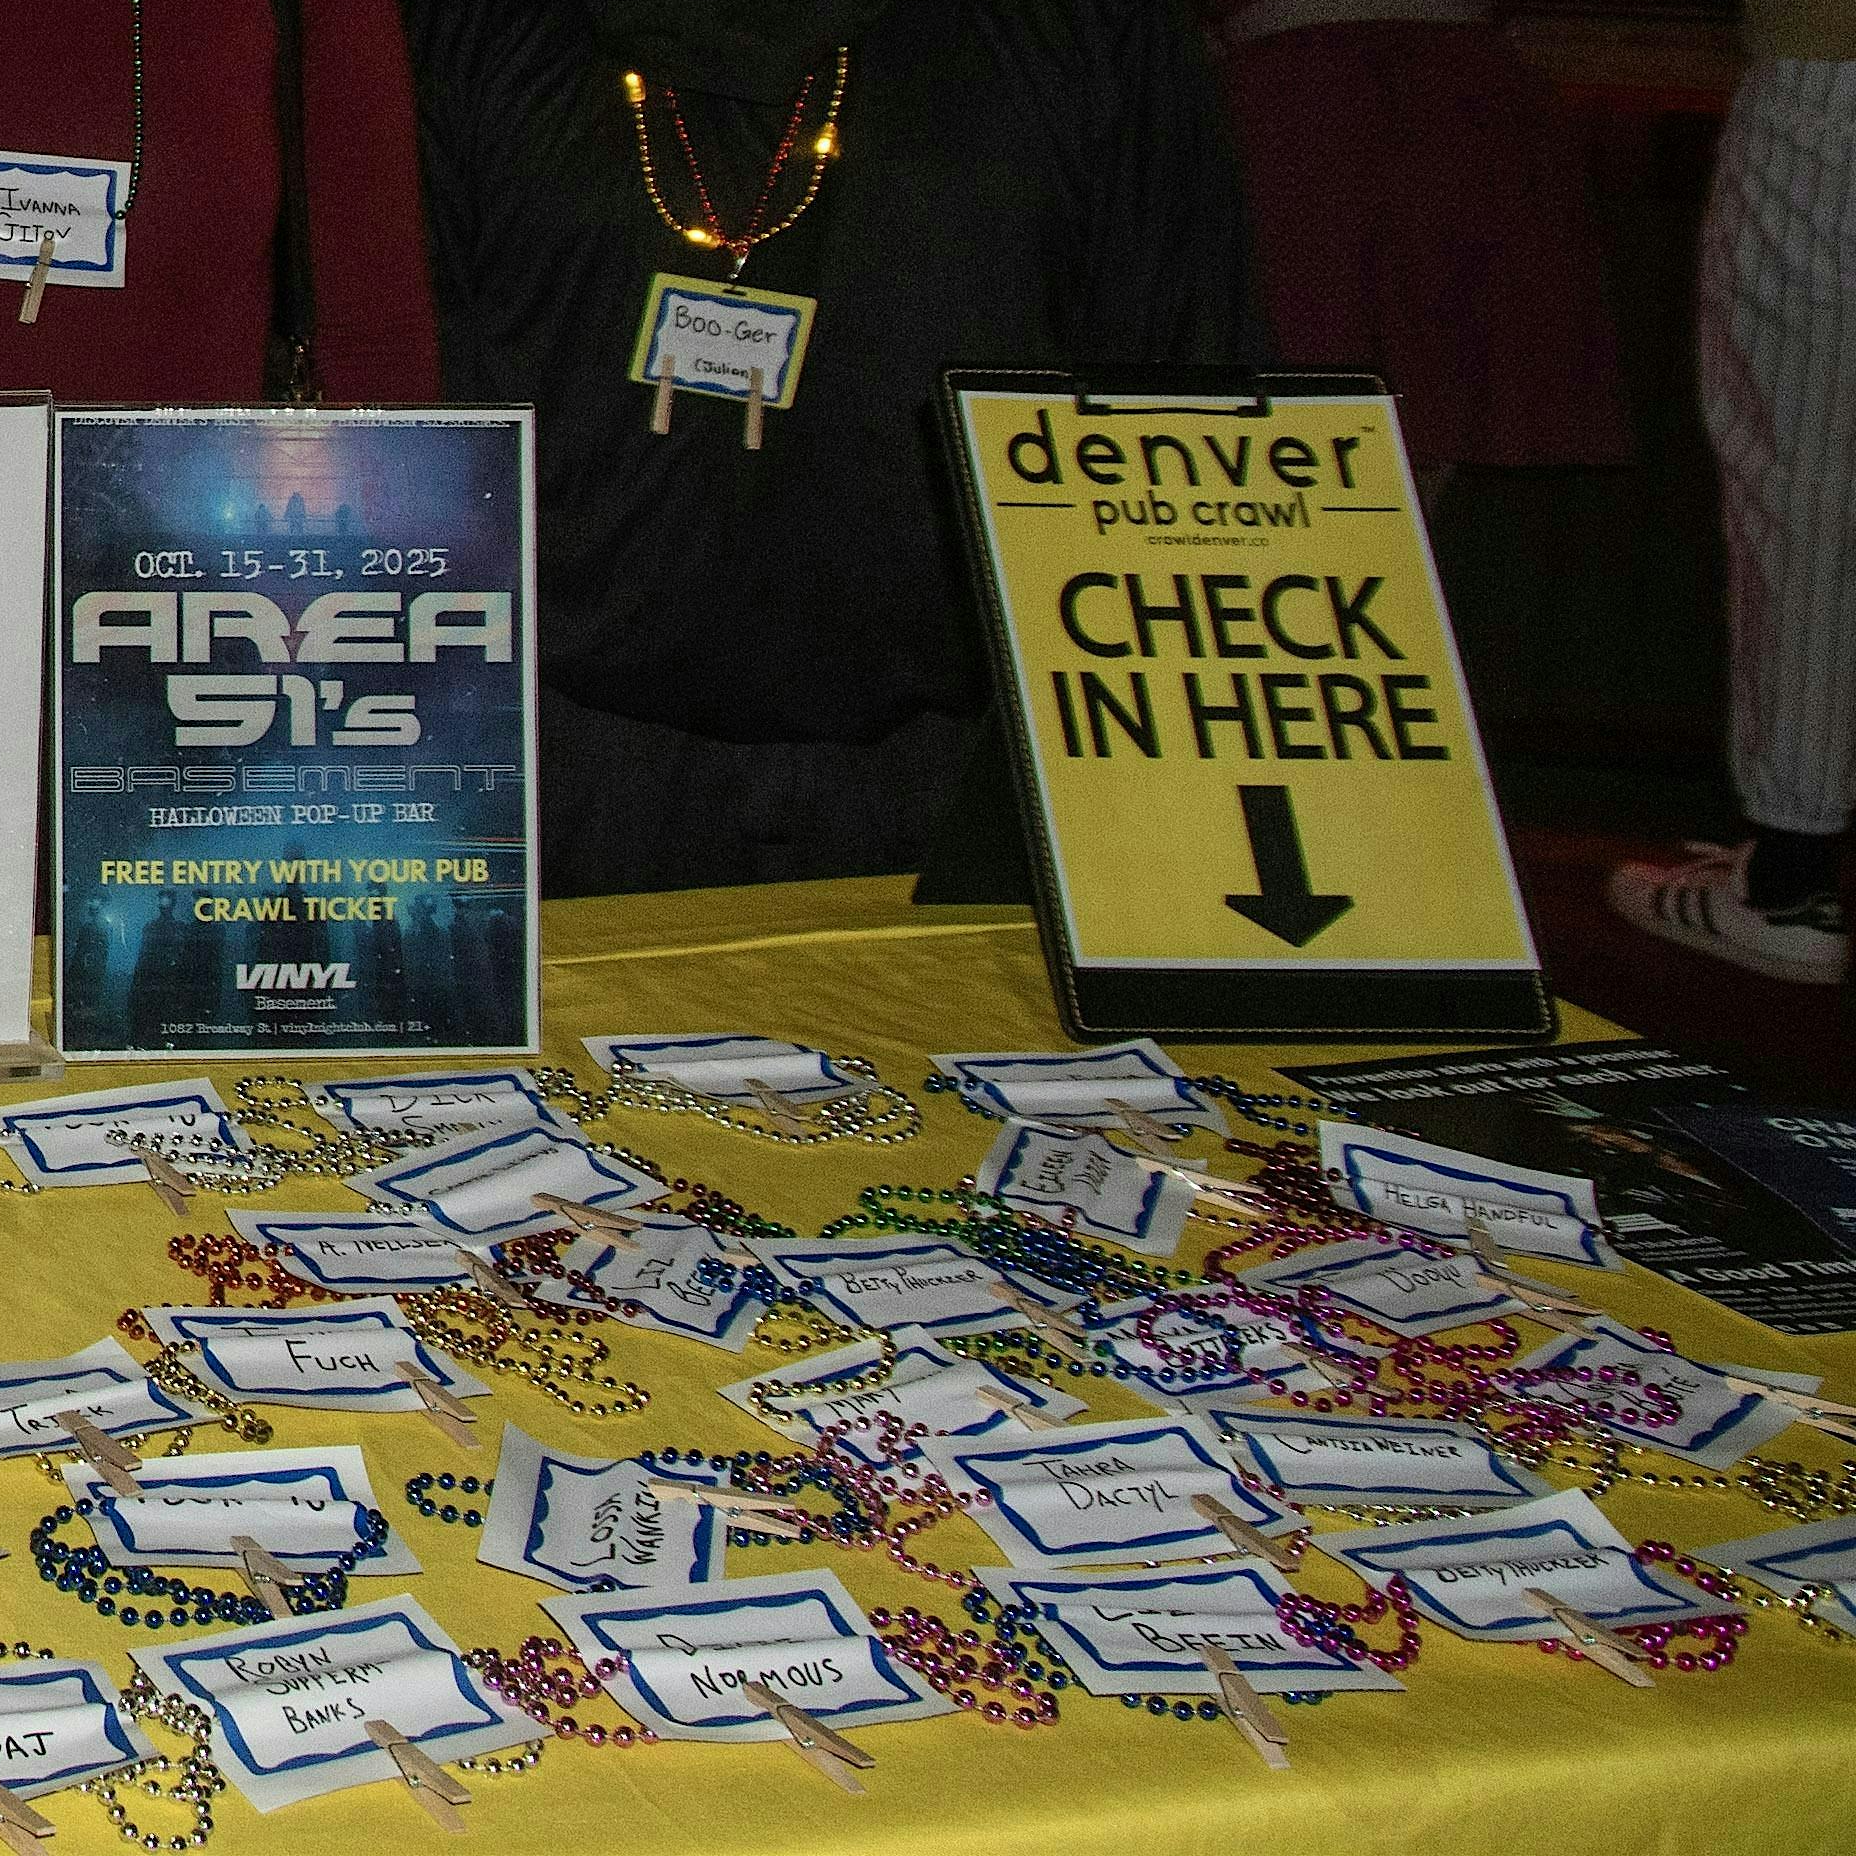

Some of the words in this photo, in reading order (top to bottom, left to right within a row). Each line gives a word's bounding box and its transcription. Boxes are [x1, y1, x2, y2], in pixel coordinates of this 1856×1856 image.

[1007, 409, 1364, 488] denver
[1094, 491, 1178, 534] pub
[1192, 491, 1310, 528] crawl
[135, 552, 205, 579] OCT.
[220, 552, 345, 580] 15-31,
[362, 548, 450, 577] 2025
[72, 591, 512, 665] AREA
[1059, 572, 1406, 660] CHECK
[167, 675, 422, 747] 51's
[1052, 671, 1161, 759] IN
[1184, 673, 1452, 761] HERE
[71, 765, 517, 794] BASEMENT
[149, 806, 282, 829] HALLOWEEN
[290, 805, 383, 827] POP-UP
[393, 804, 438, 824] BAR
[101, 862, 164, 884] FREE
[172, 862, 261, 885] ENTRY
[271, 861, 341, 884] WITH
[348, 859, 429, 884] YOUR
[435, 859, 490, 884] PUB
[195, 898, 296, 923] CRAWL
[303, 897, 398, 922] TICKET
[236, 964, 357, 990] VINYL
[1388, 1083, 1444, 1101] look
[1452, 1081, 1493, 1097] out
[1521, 1075, 1557, 1091] for
[1561, 1069, 1623, 1086] each
[1638, 1064, 1729, 1080] other.
[1462, 1198, 1558, 1229] HANDFUL
[286, 1341, 379, 1374] FUCH
[1024, 1458, 1136, 1480] TAHRA
[1058, 1479, 1181, 1511] DACTYL
[283, 1697, 366, 1734] BANKS
